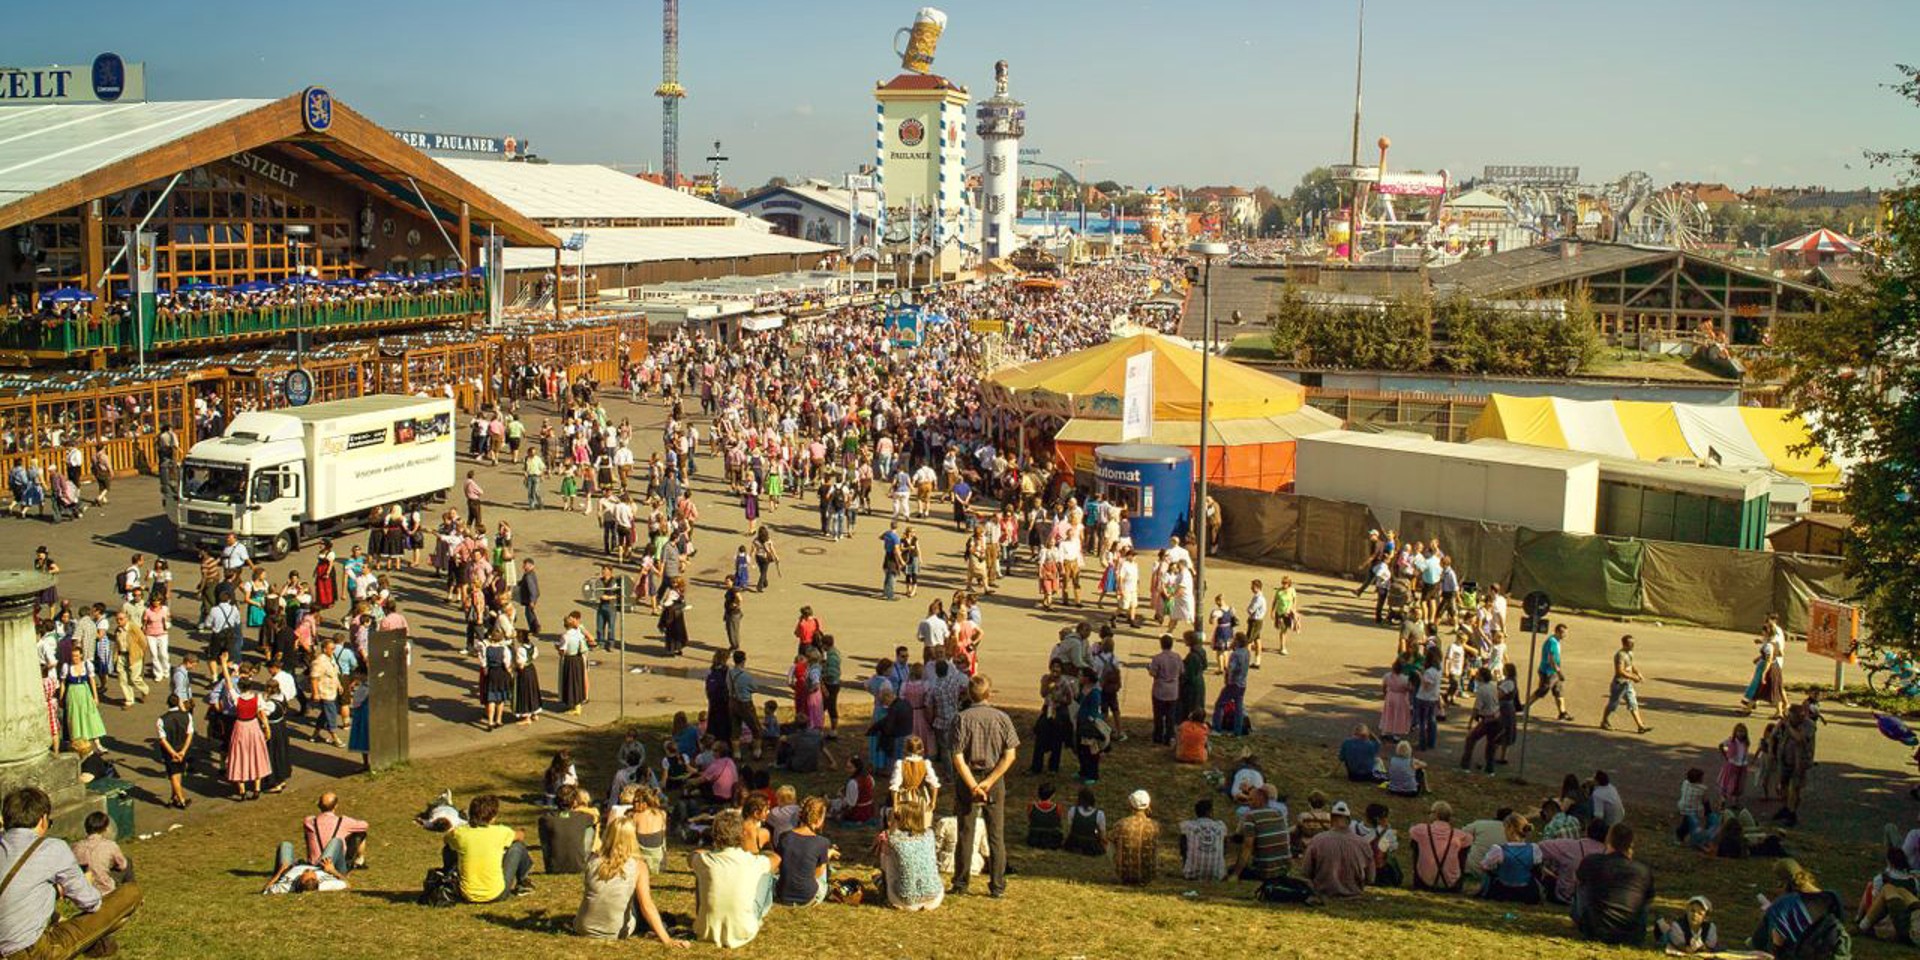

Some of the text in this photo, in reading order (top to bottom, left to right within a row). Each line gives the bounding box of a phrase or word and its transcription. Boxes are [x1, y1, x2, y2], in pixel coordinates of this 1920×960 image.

[0, 70, 72, 98] ELT
[435, 134, 499, 153] PAULANER.
[890, 151, 932, 160] PAULANER
[1098, 466, 1141, 482] utomat
